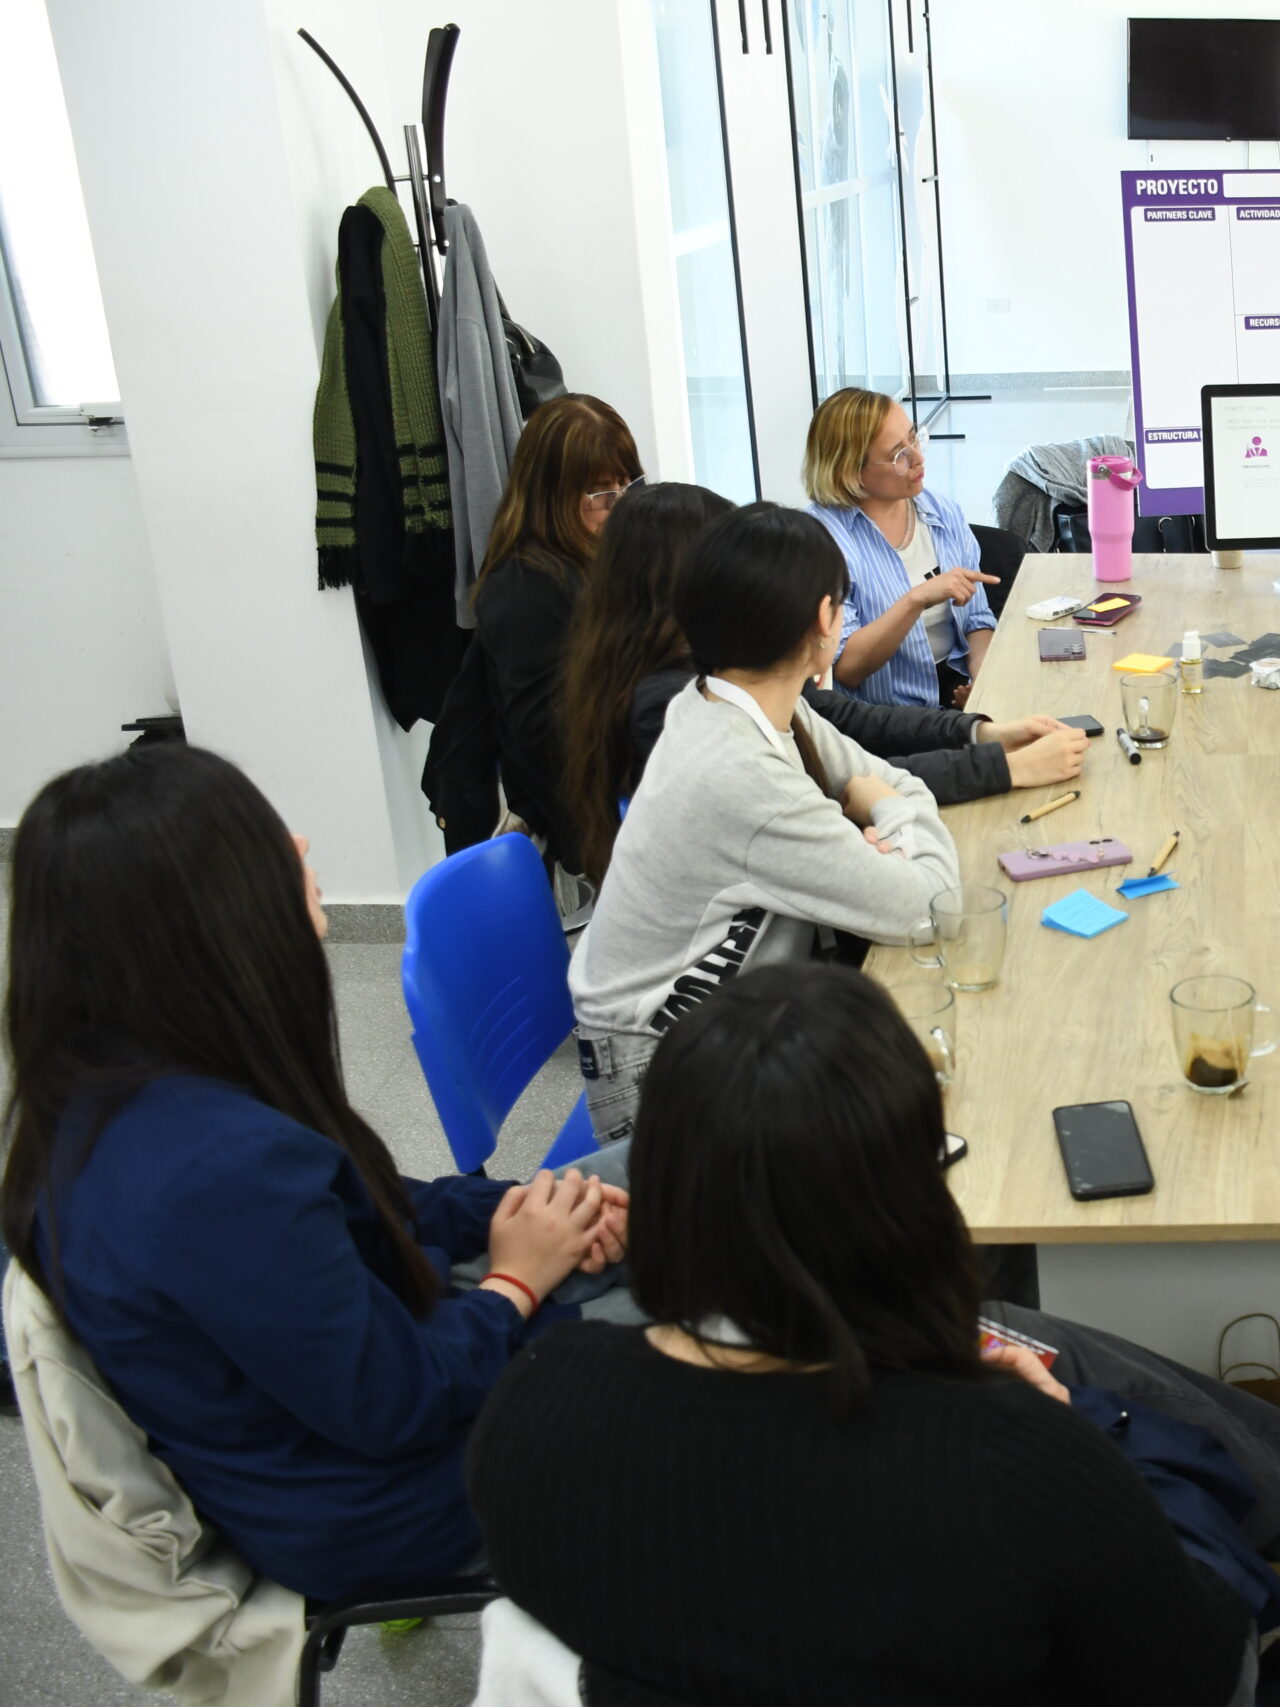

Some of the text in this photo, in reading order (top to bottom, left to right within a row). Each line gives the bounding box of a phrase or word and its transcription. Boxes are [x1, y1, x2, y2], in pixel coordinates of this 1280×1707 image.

[1136, 178, 1219, 196] PROYECTO
[1146, 210, 1213, 221] PARTNERS CLAVE
[1147, 430, 1199, 441] ESTRUCTURA
